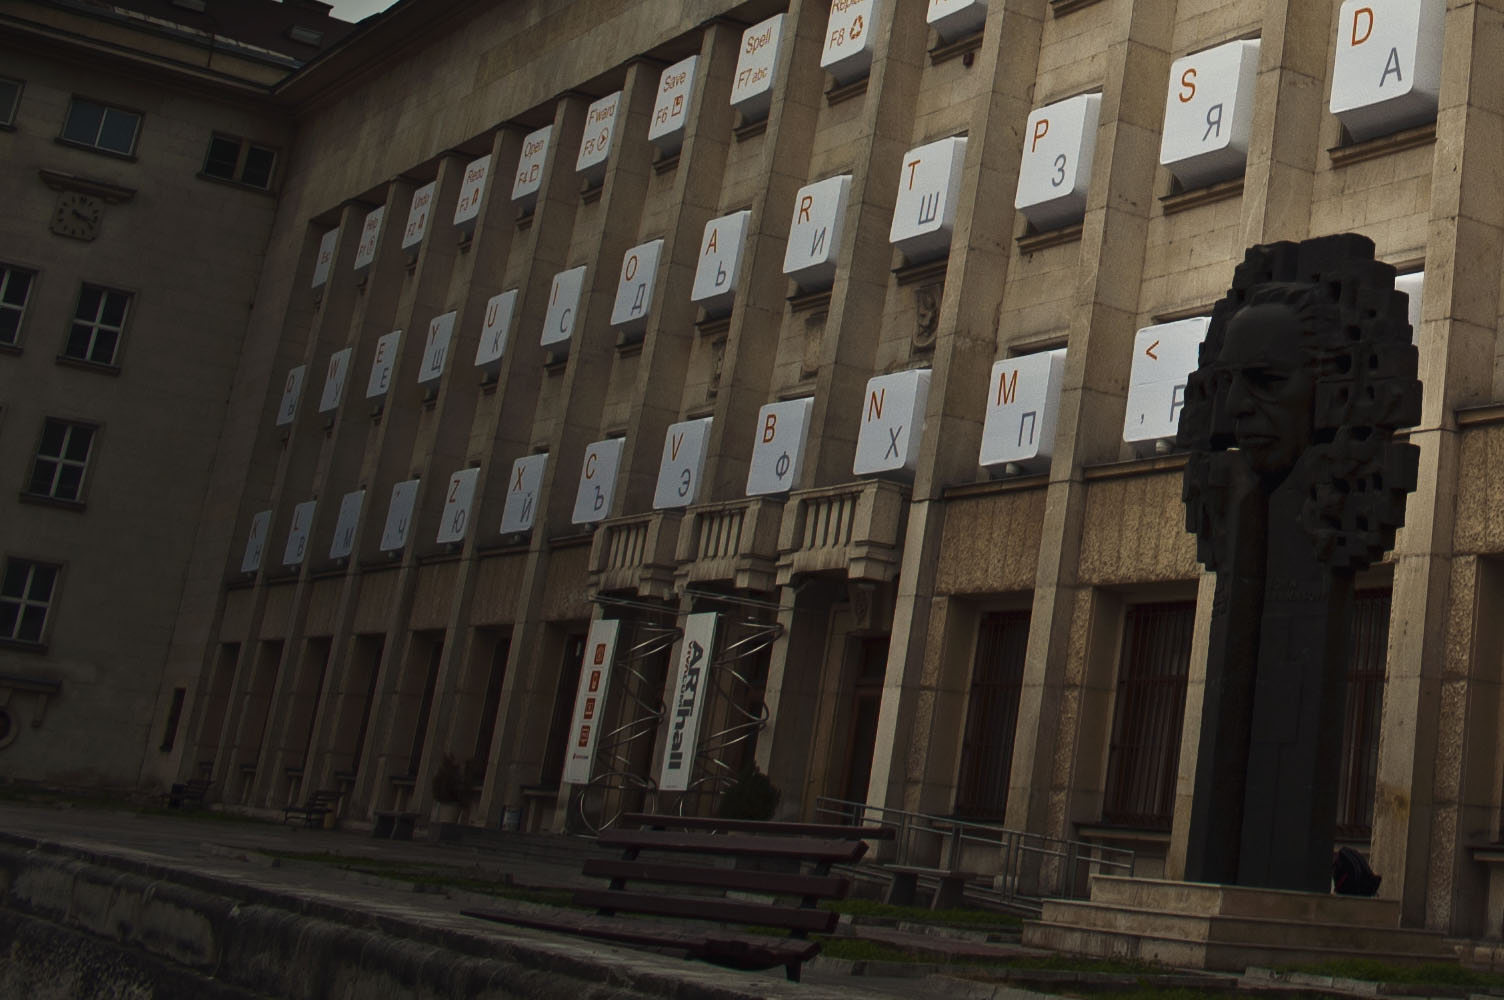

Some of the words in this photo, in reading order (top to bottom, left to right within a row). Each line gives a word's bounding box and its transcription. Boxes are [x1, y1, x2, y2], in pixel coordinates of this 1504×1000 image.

[745, 26, 772, 55] Spell
[829, 27, 845, 50] F8
[1350, 6, 1375, 48] D
[663, 71, 687, 93] Save
[737, 67, 753, 90] F7
[1378, 46, 1403, 89] А
[1178, 67, 1198, 104] S
[654, 107, 668, 128] F6
[1201, 102, 1224, 143] Я
[1031, 118, 1050, 154] P
[907, 159, 921, 191] T
[797, 195, 814, 225] R
[918, 191, 940, 226] Ш
[705, 227, 718, 256] A
[810, 226, 827, 257] И
[630, 283, 647, 316] Д
[487, 303, 499, 329] U
[376, 341, 387, 365] E
[996, 369, 1020, 407] M
[867, 388, 886, 423] N
[762, 413, 778, 444] B
[884, 425, 903, 461] Х
[1017, 410, 1038, 449] П
[671, 432, 685, 462] V
[512, 464, 527, 492] X
[585, 452, 598, 480] C
[775, 450, 791, 482] Ф
[448, 479, 462, 504] Z
[678, 468, 692, 498] Э
[519, 490, 534, 523] Й
